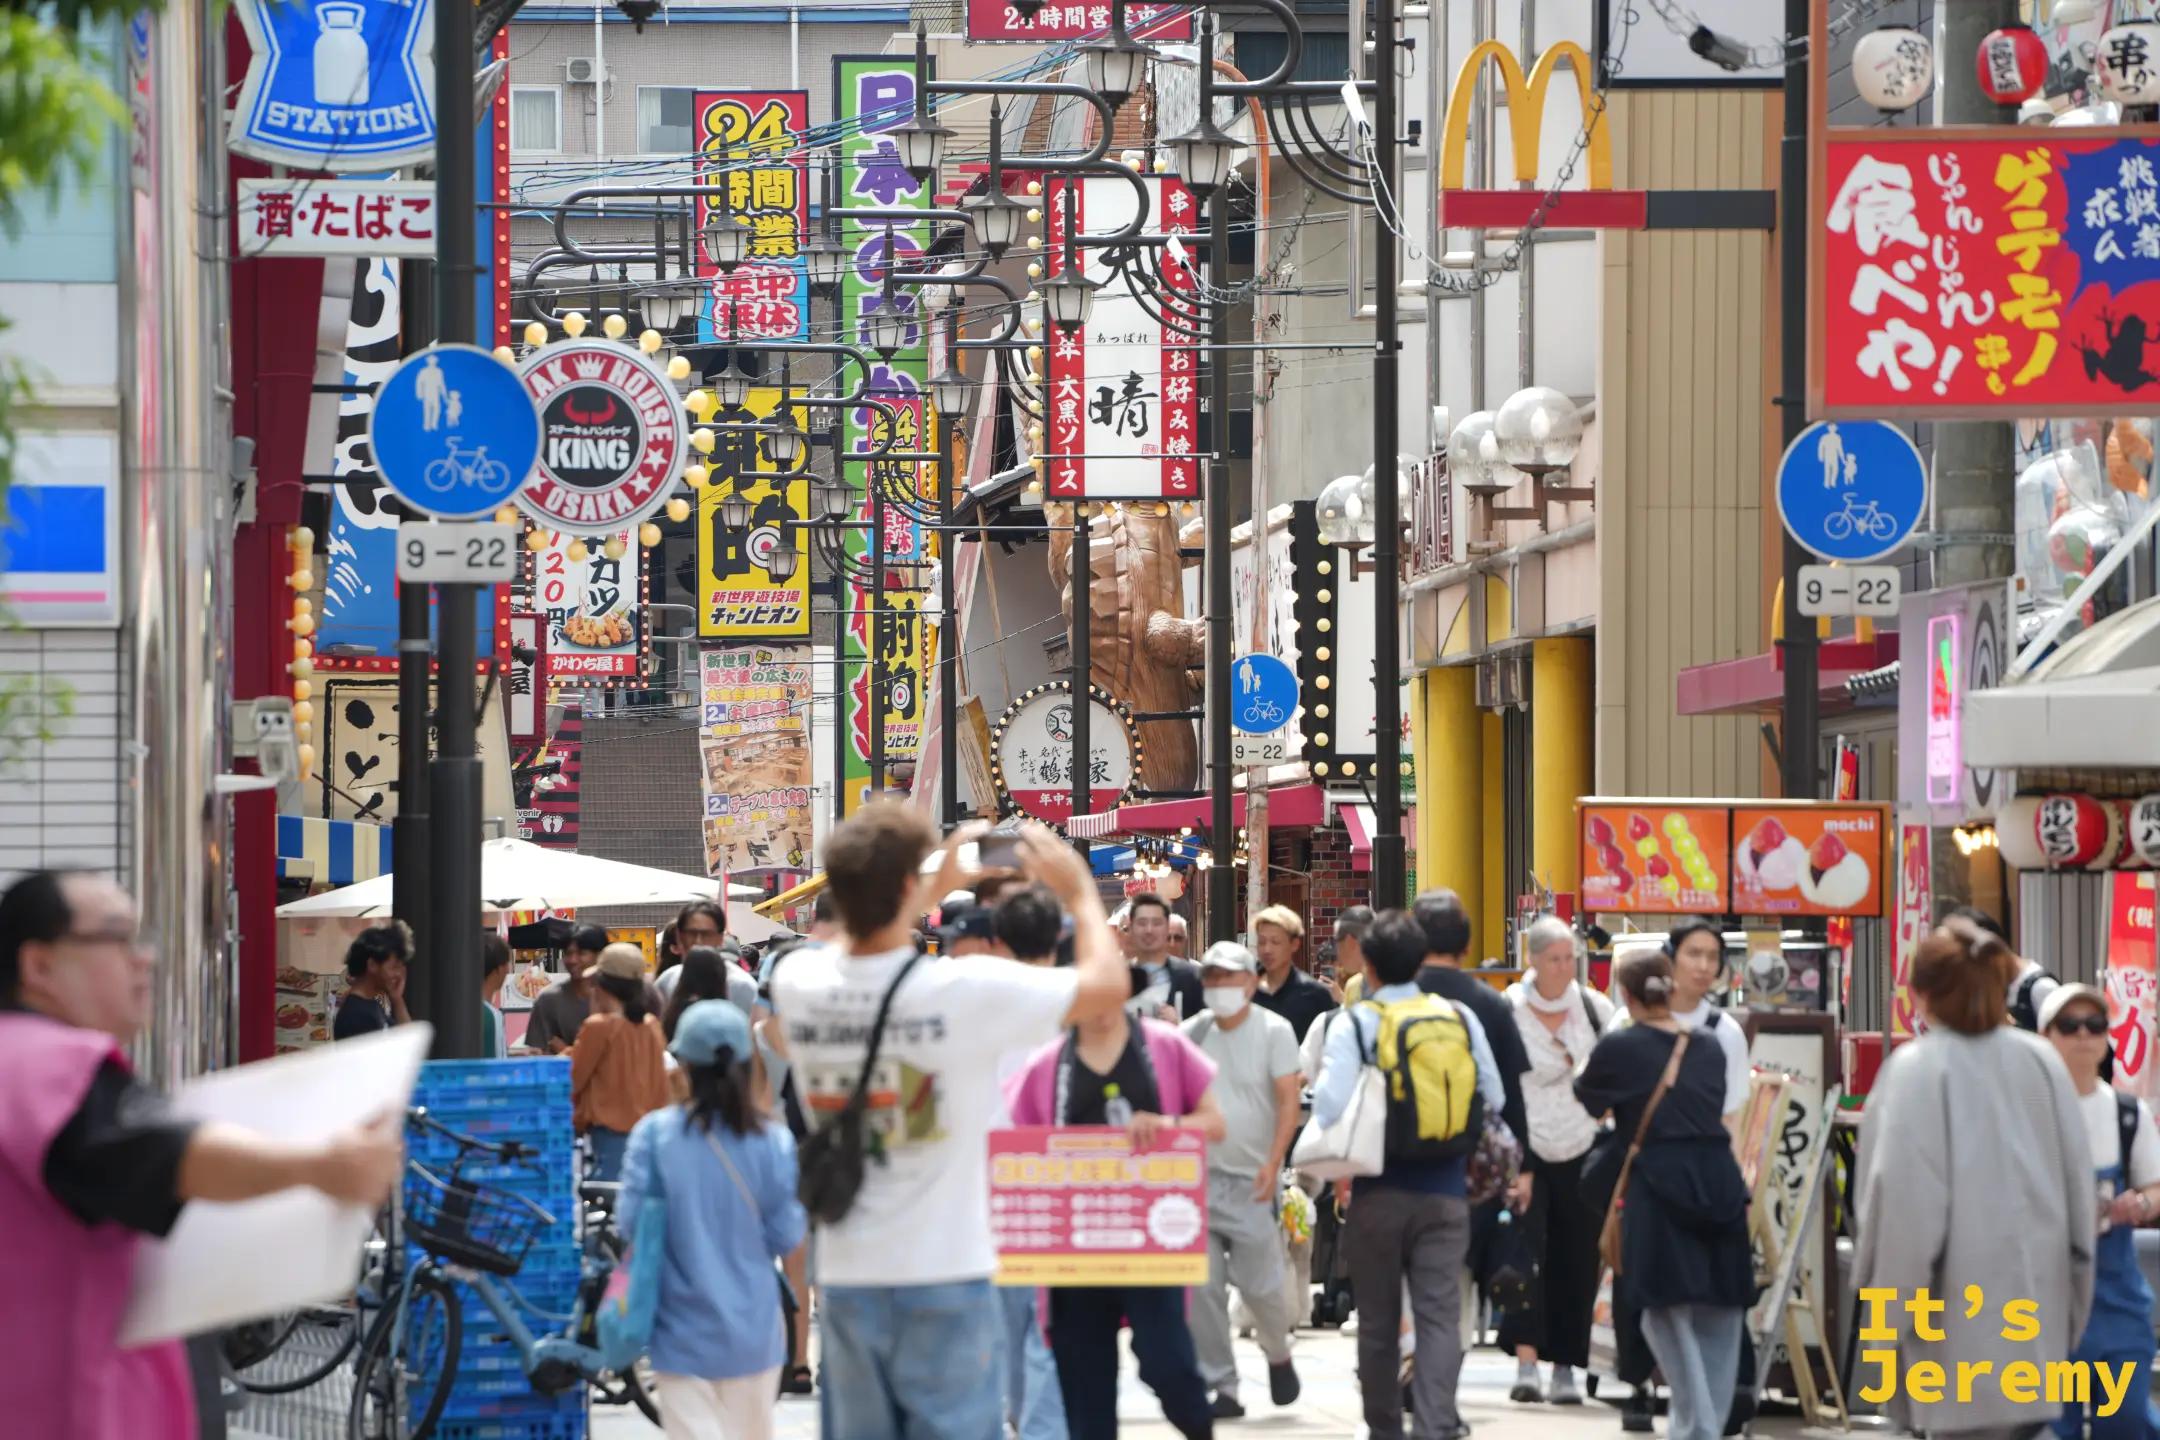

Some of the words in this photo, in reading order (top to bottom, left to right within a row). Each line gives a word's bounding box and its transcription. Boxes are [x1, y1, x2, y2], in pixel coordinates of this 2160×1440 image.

[266, 101, 420, 135] STATION
[256, 192, 433, 240] 酒・たばこ
[1928, 152, 1995, 329] じゃんじゃん
[1994, 147, 2062, 386] ゲテモノ
[607, 358, 673, 442] HOUSE
[1055, 373, 1082, 490] 大黒ソース
[549, 438, 630, 470] KING
[544, 485, 635, 521] OSAKA
[711, 590, 801, 605] 新世界遊技場
[710, 606, 802, 625] チャンピオン
[552, 655, 614, 671] かわち屋
[706, 653, 751, 668] 新世界
[883, 723, 918, 733] 世界遊技場
[883, 734, 919, 748] ャンピオン
[1235, 744, 1283, 760] 9-22
[1824, 816, 1876, 832] mochi
